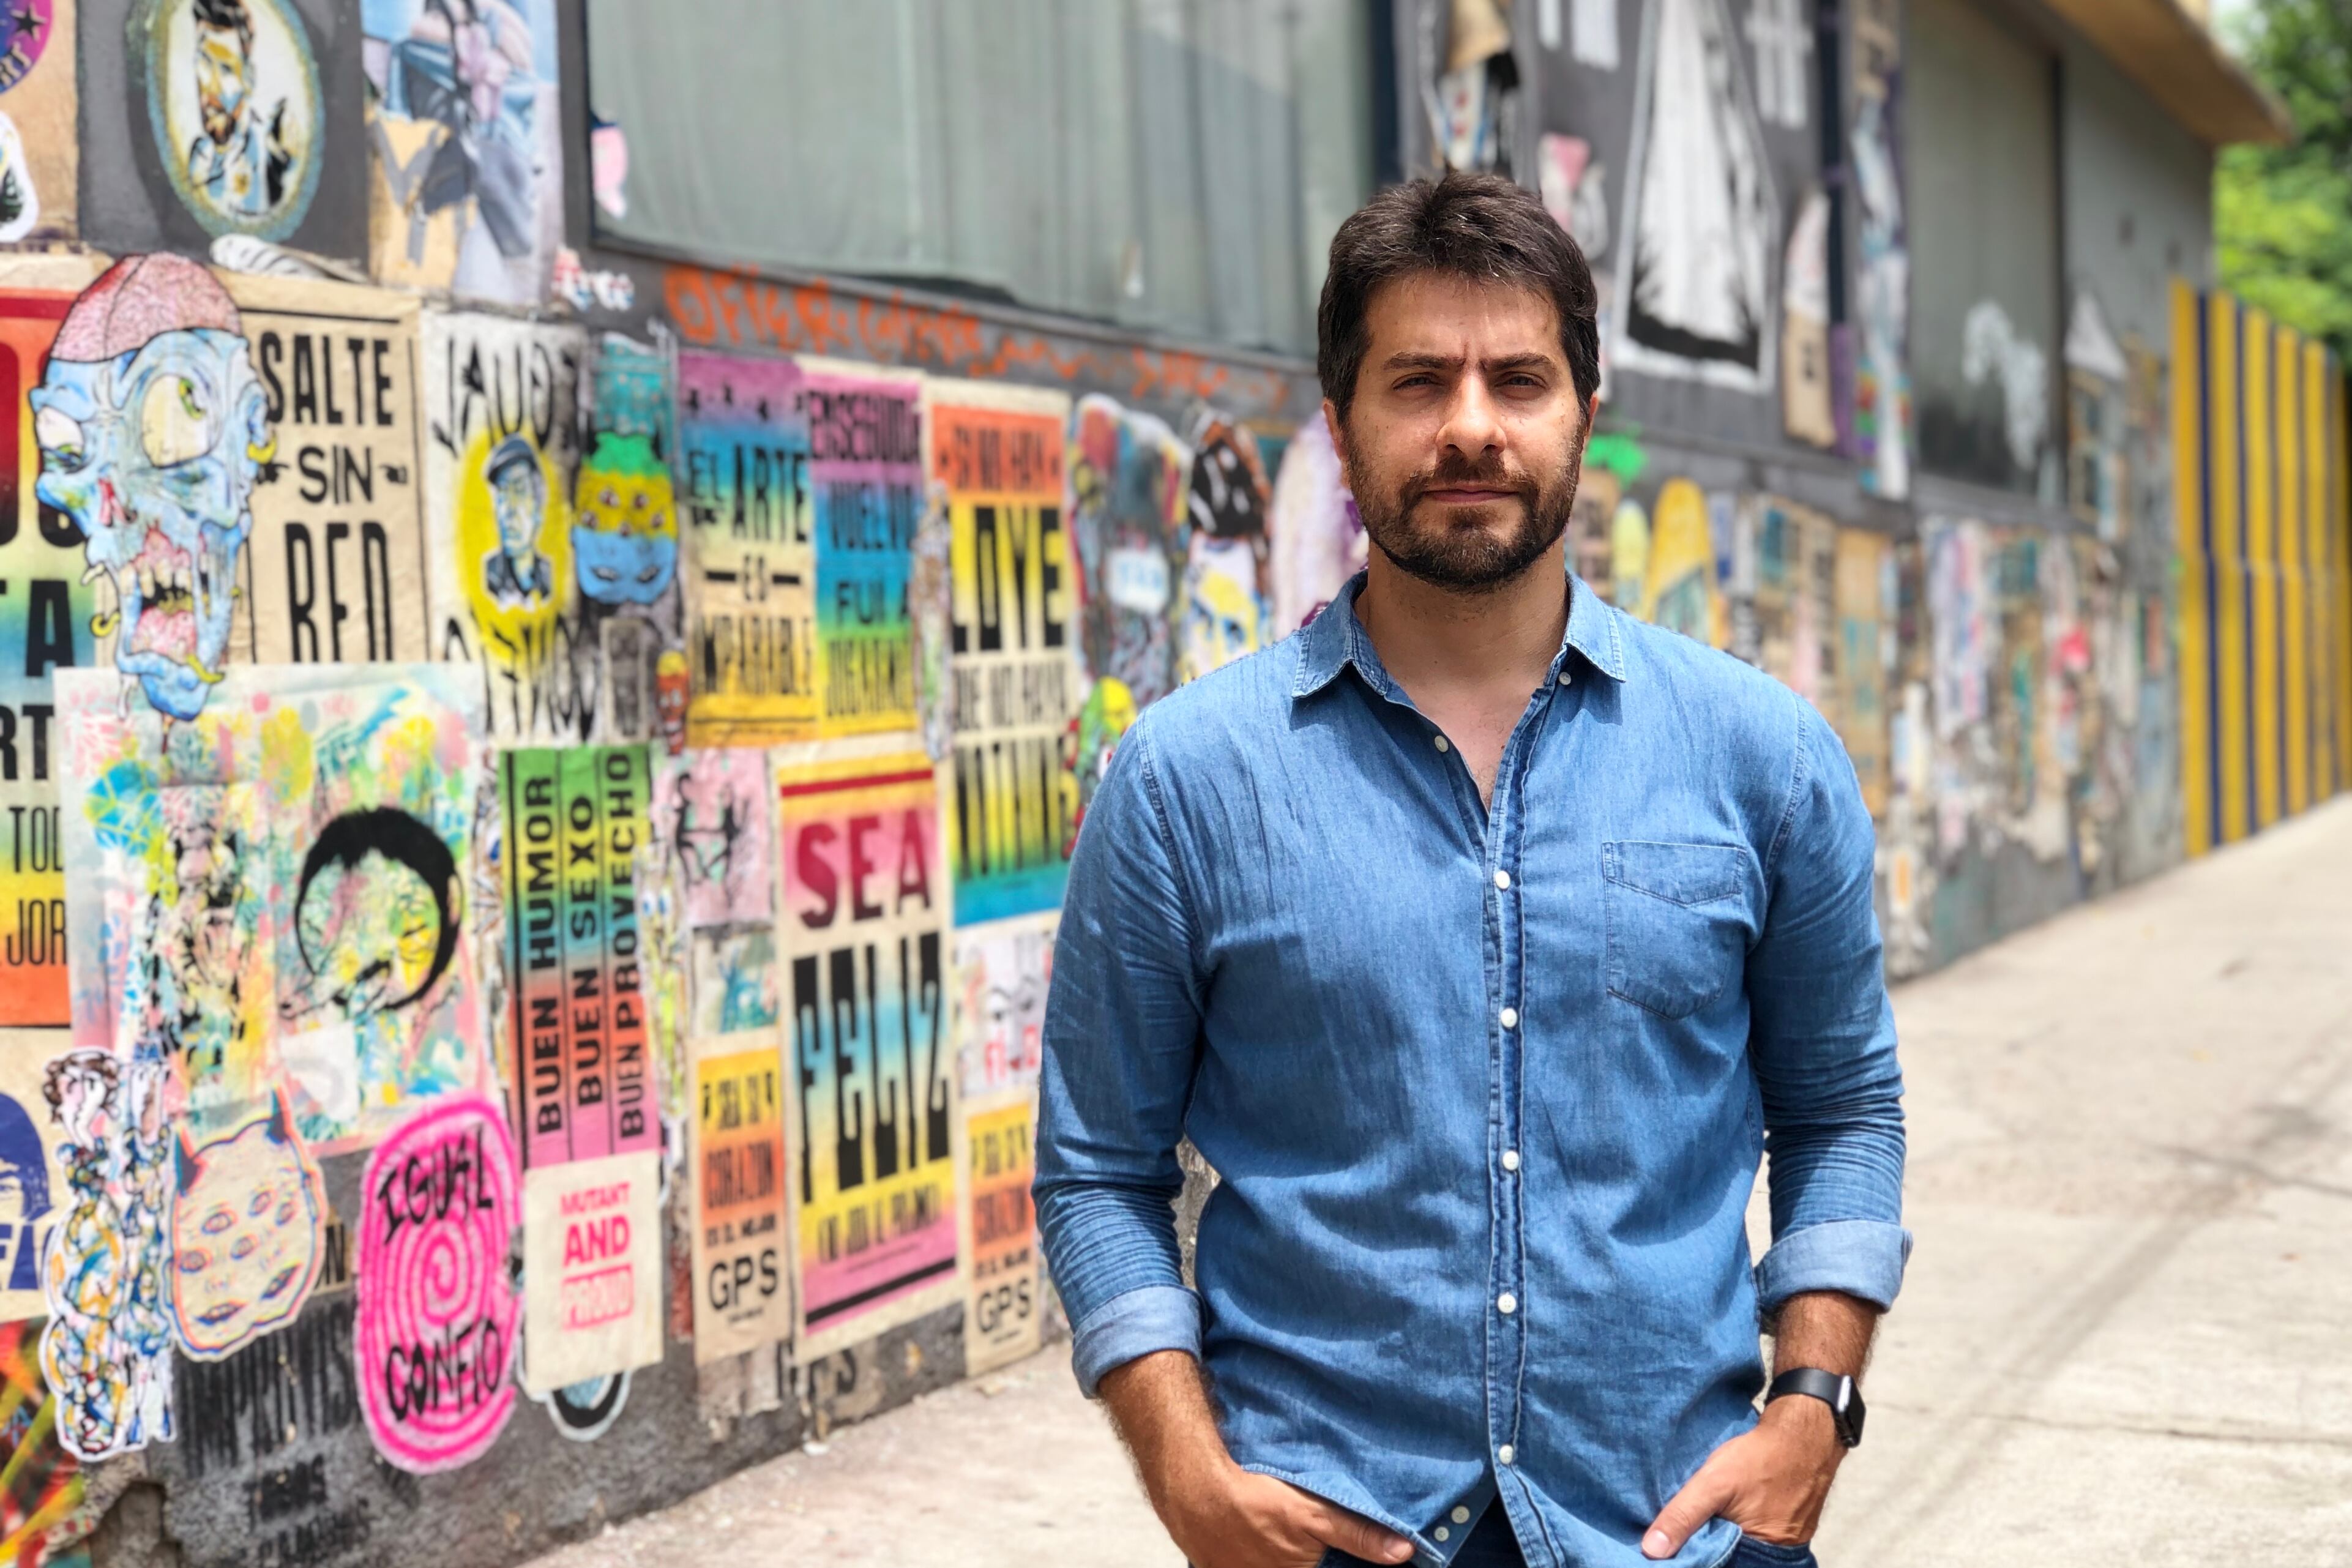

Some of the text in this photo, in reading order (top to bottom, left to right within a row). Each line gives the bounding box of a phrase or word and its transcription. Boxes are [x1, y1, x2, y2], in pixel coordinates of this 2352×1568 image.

[260, 331, 393, 425] SALTE
[297, 445, 373, 504] SIN
[688, 444, 809, 543] EL ARTE
[835, 579, 885, 626] FUI
[945, 504, 1064, 654] LOVE
[797, 808, 930, 929] SEA
[524, 774, 564, 1134] BUEN HUMOR
[570, 797, 605, 1108] BUEN SEXO
[605, 751, 646, 1140] BUEN PROVECHO
[792, 931, 950, 1204] FELIZ
[559, 1182, 631, 1217] MUTANT
[562, 1214, 631, 1269] AND
[708, 1249, 780, 1312] GPS
[977, 1277, 1032, 1334] GPS
[386, 1316, 502, 1423] CONFIO
